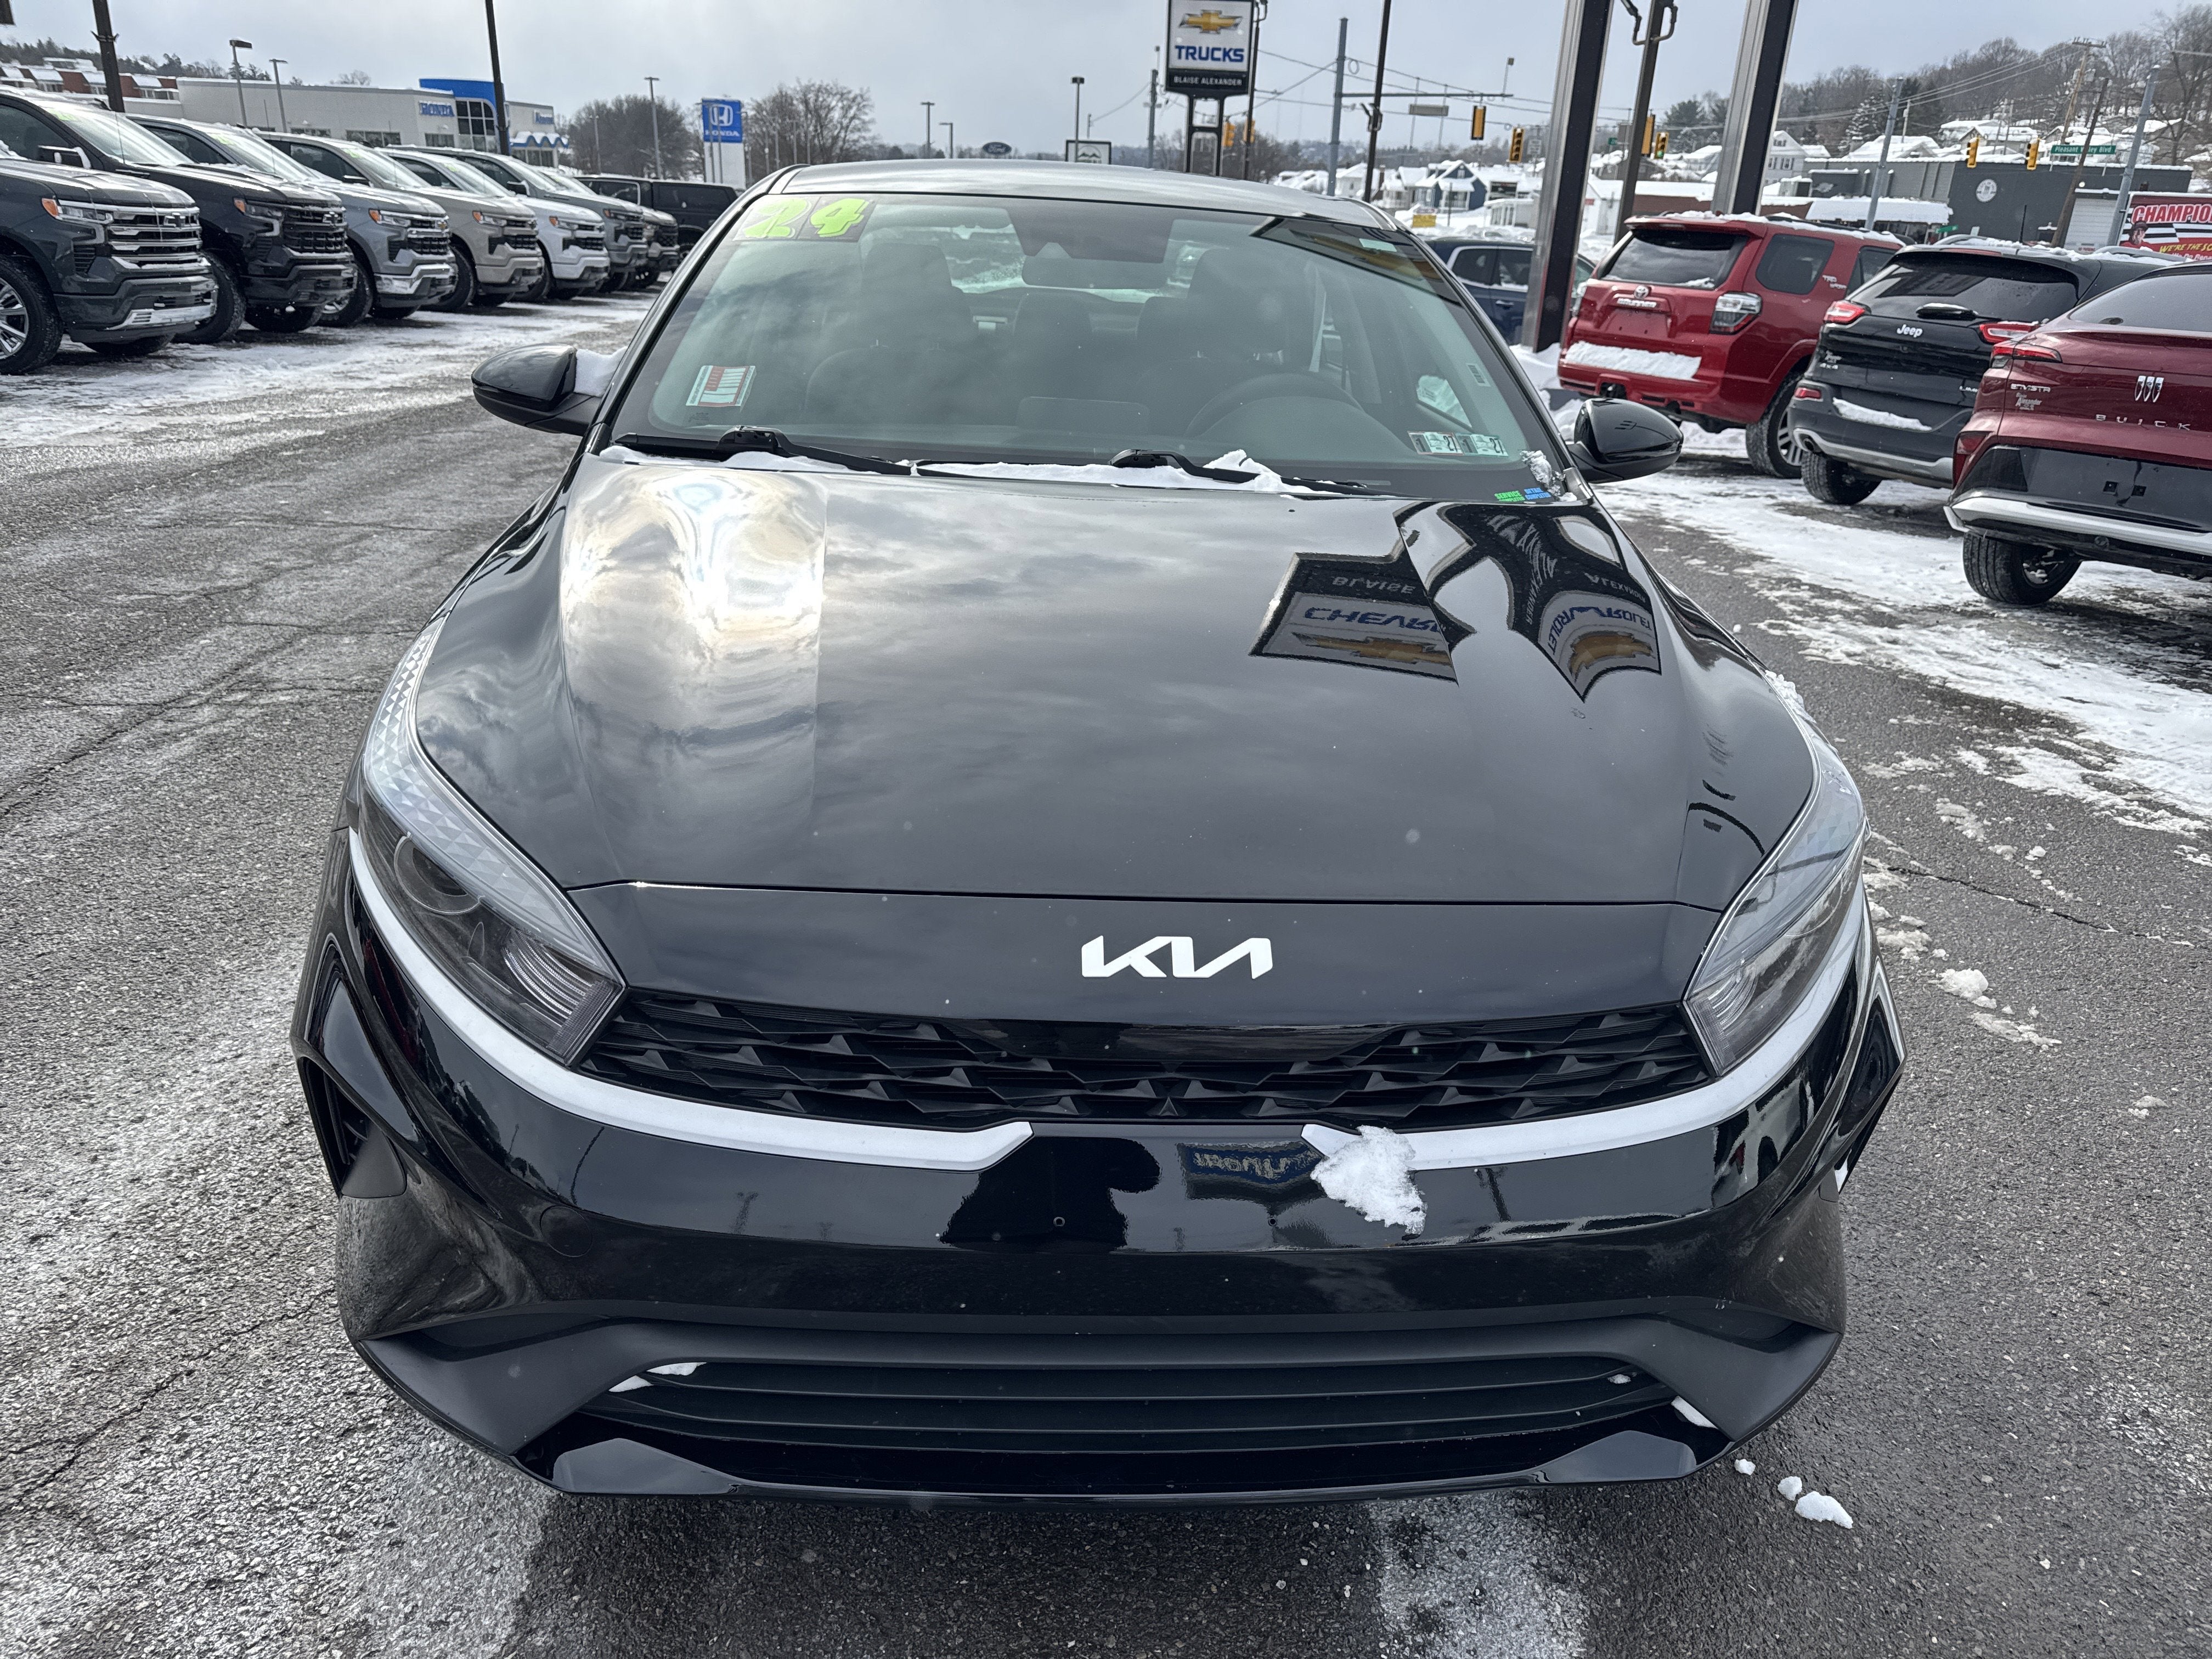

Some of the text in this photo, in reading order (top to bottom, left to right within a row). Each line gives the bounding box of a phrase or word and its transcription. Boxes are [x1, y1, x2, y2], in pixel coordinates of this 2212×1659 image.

[1175, 45, 1244, 63] TRUCKS
[1173, 75, 1242, 86] BLAISE ALEXANDER
[2131, 205, 2212, 223] CHAMPIO
[2159, 244, 2186, 253] WE'RE
[2187, 242, 2203, 251] THE
[1897, 324, 1923, 338] Jeep
[2096, 414, 2191, 431] BUICK
[1494, 490, 1522, 499] SERVICE
[1081, 935, 1273, 979] KIA
